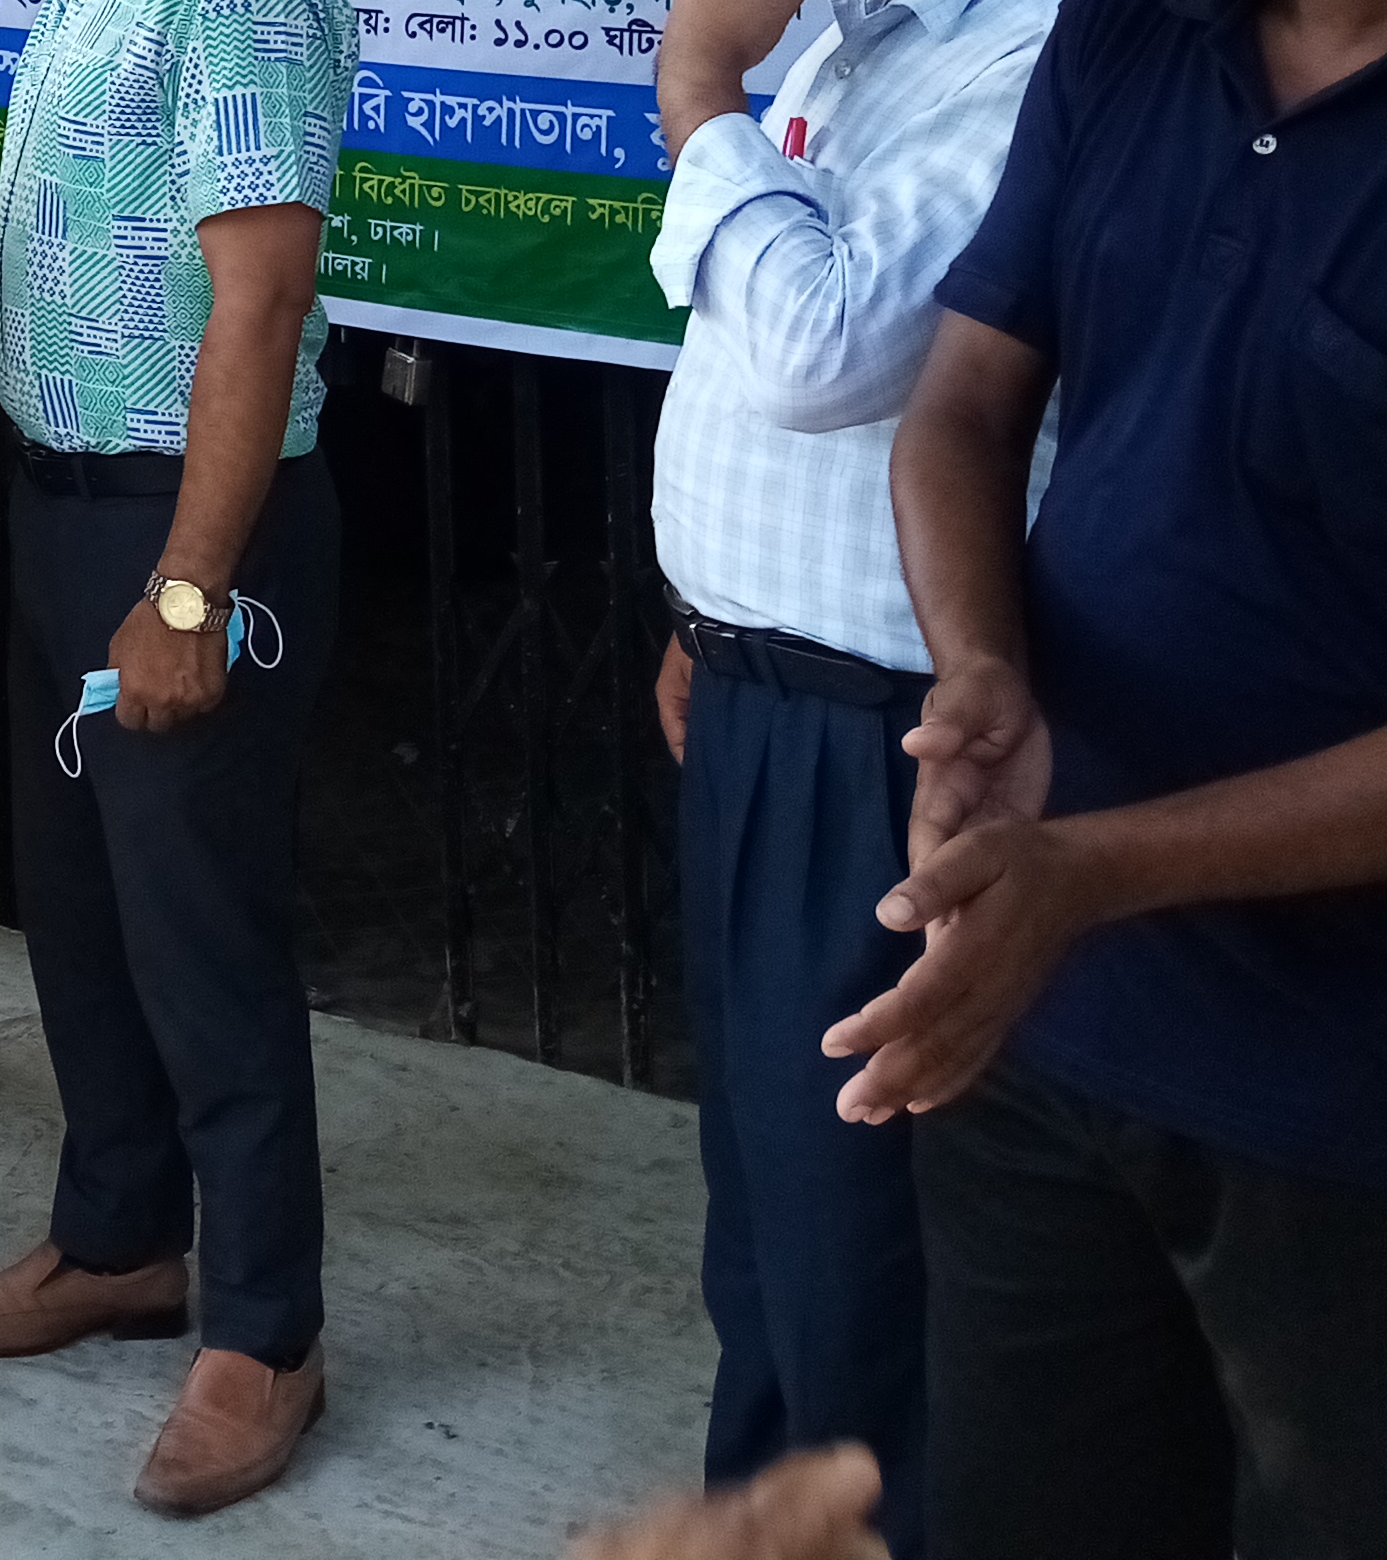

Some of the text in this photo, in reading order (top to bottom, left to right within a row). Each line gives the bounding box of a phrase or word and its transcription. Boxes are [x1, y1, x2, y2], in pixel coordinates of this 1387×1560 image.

[405, 12, 477, 45] বেলা:
[493, 18, 590, 52] ১১.০০
[400, 88, 626, 169] হাসপাতাল,
[457, 184, 577, 226] চরাঞ্চলে
[367, 218, 424, 249] ঢাকা
